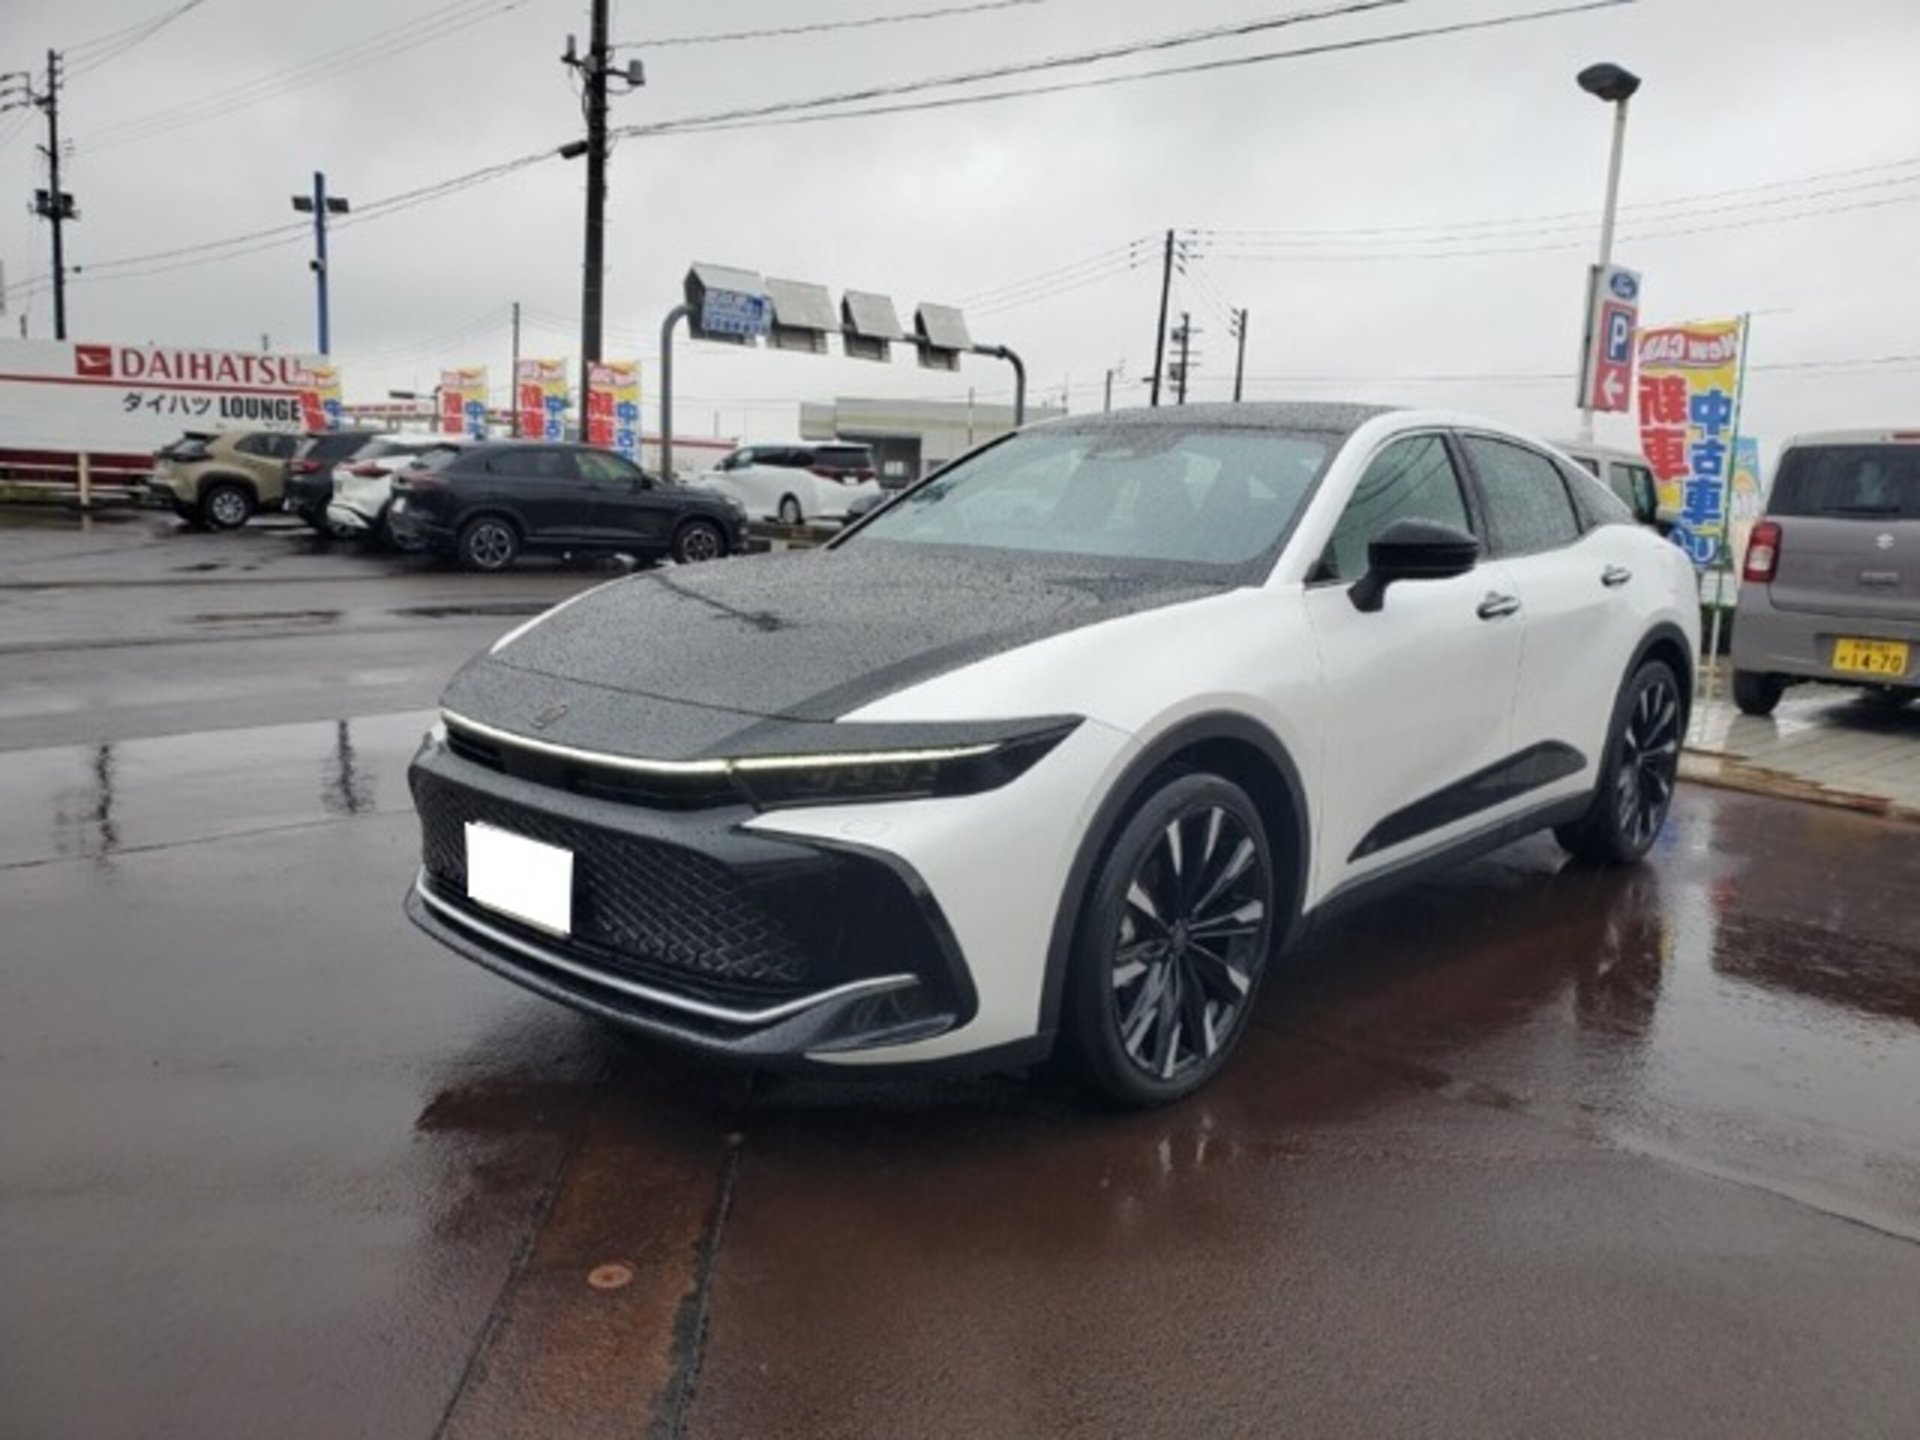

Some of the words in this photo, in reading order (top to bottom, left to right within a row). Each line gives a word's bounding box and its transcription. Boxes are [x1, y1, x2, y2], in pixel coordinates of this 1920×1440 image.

[1609, 313, 1628, 359] P
[120, 349, 302, 386] DAIHATSU
[123, 392, 212, 415] ダイハツ
[220, 396, 301, 421] LOUNGE
